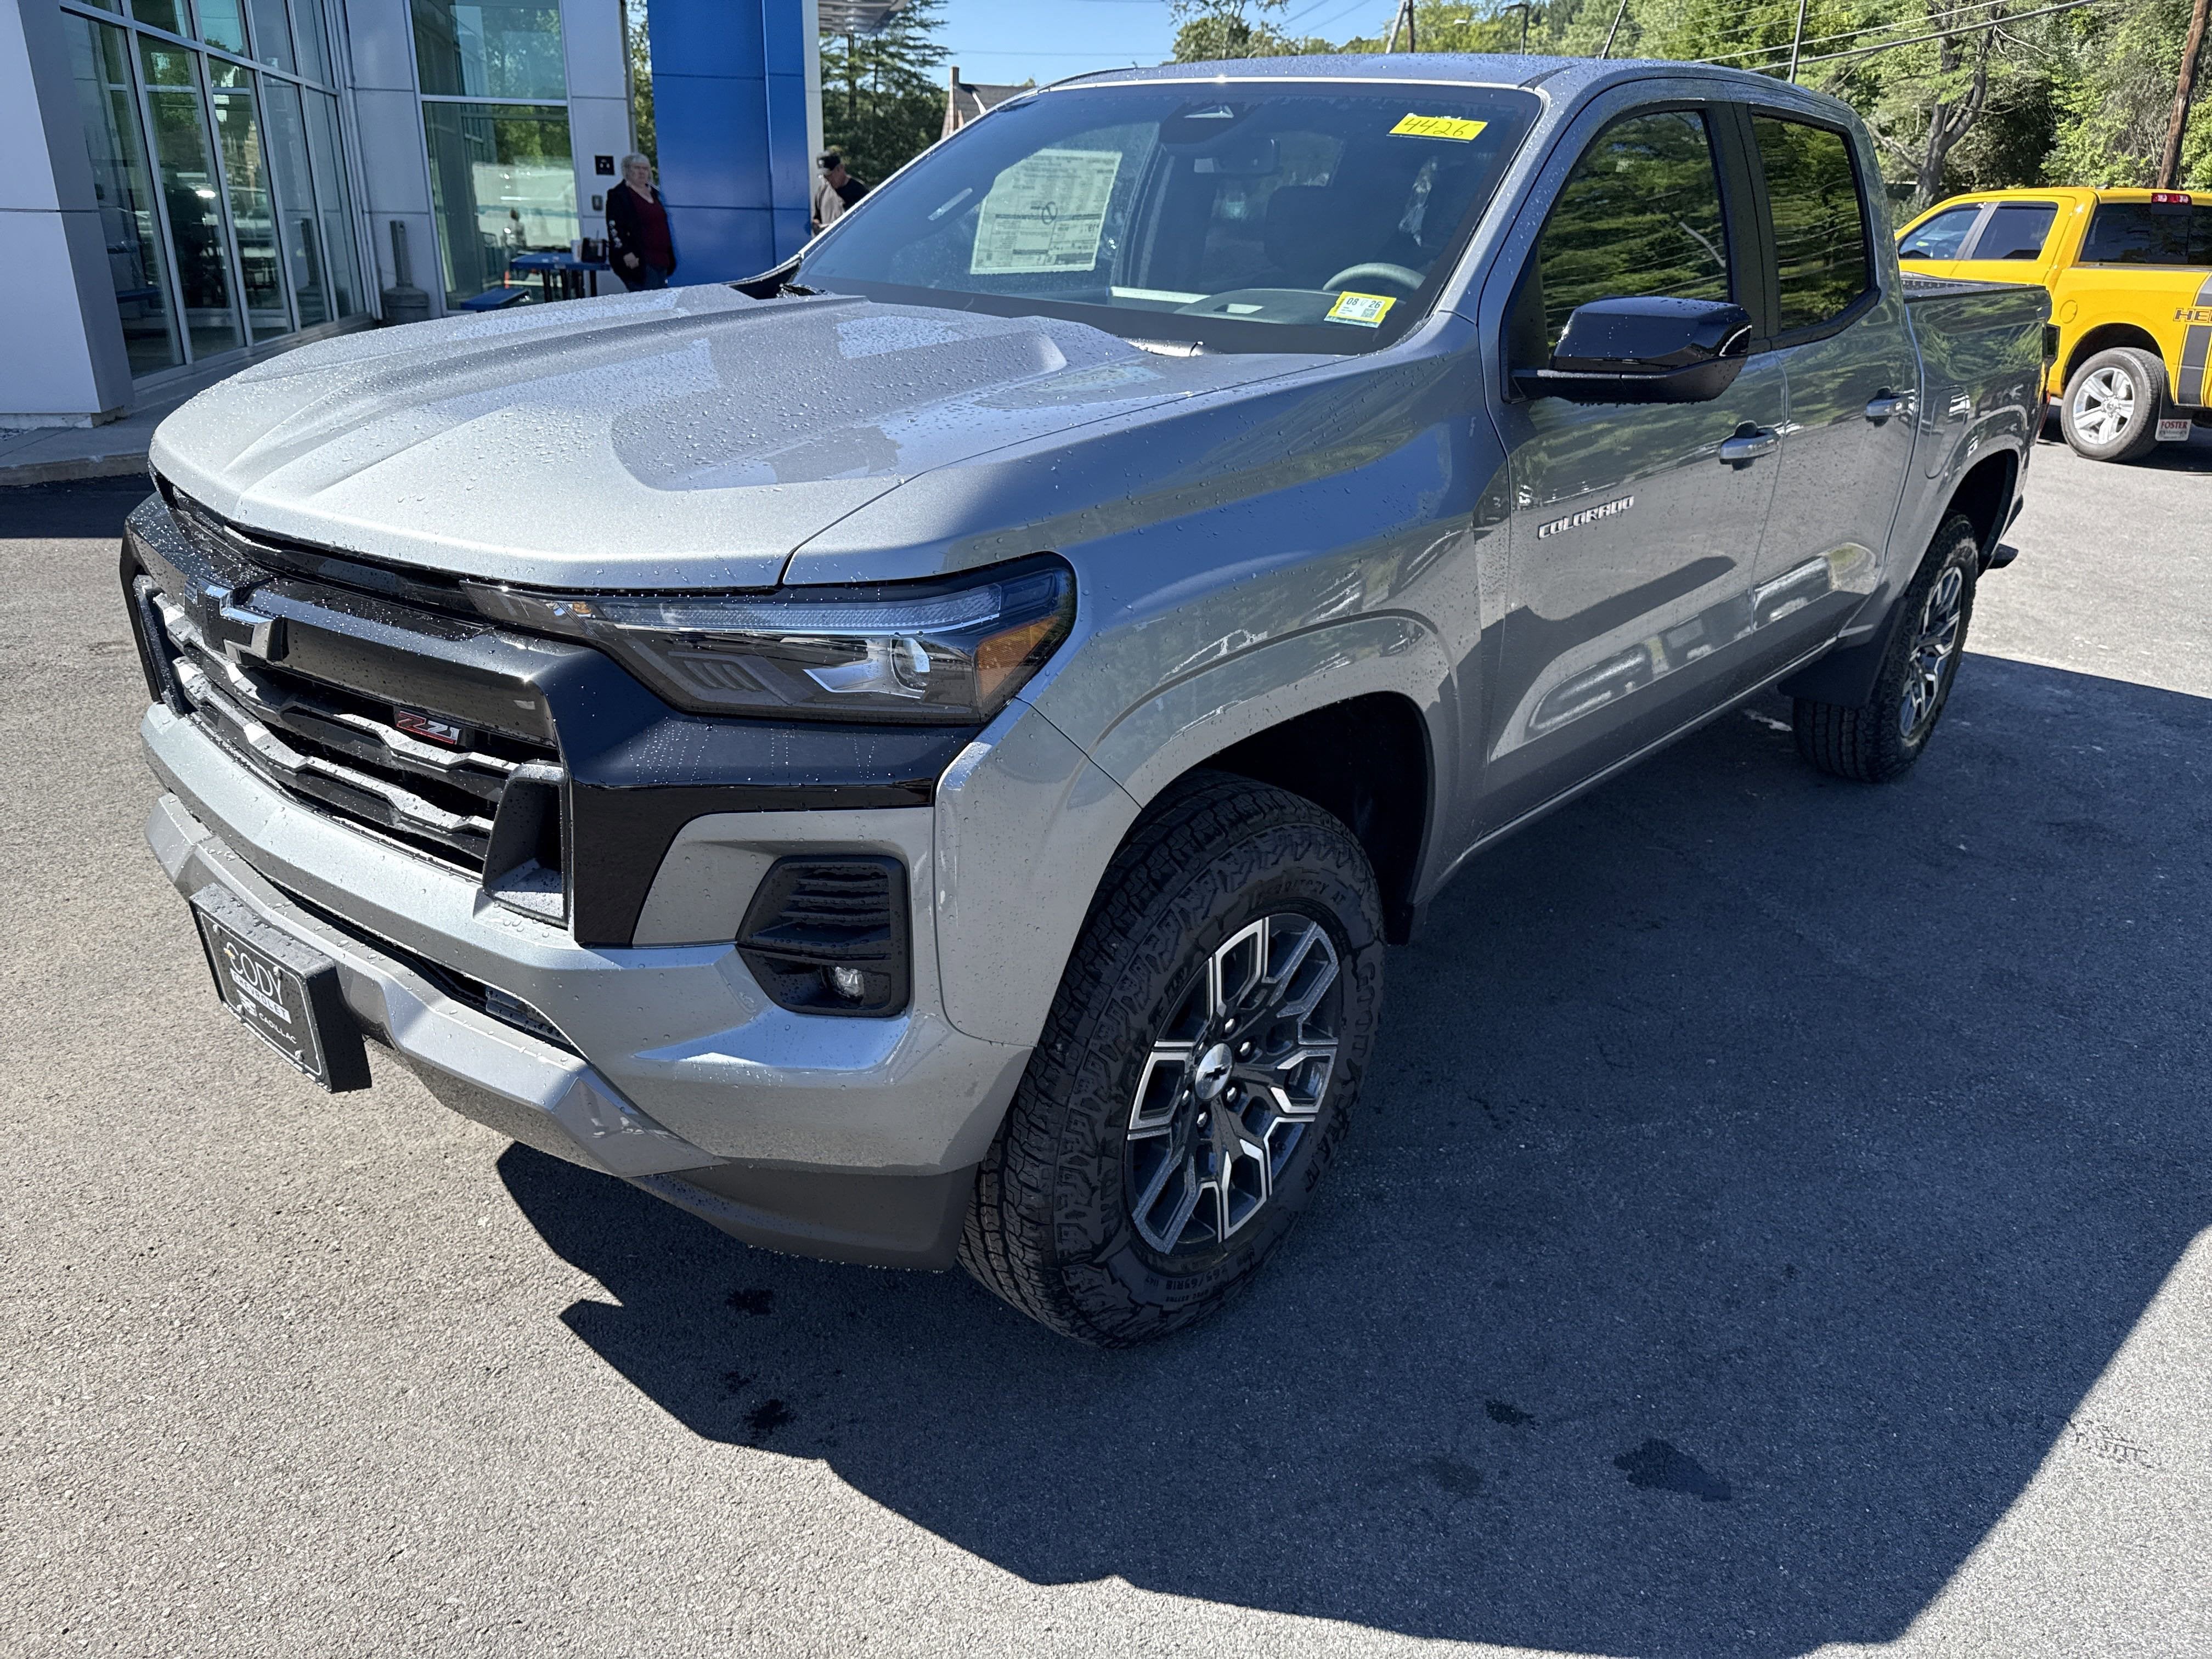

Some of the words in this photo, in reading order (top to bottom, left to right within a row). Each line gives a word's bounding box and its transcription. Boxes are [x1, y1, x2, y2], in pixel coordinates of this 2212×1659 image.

[1346, 297, 1359, 306] 08
[1368, 300, 1382, 309] 26
[2173, 307, 2212, 323] HE
[2161, 421, 2188, 429] FOSTER
[1537, 495, 1634, 539] COLORADO
[396, 710, 462, 745] Z71
[223, 941, 283, 1006] CODY
[233, 973, 288, 1019] CHEVROLET
[258, 1012, 297, 1045] CADILLAC
